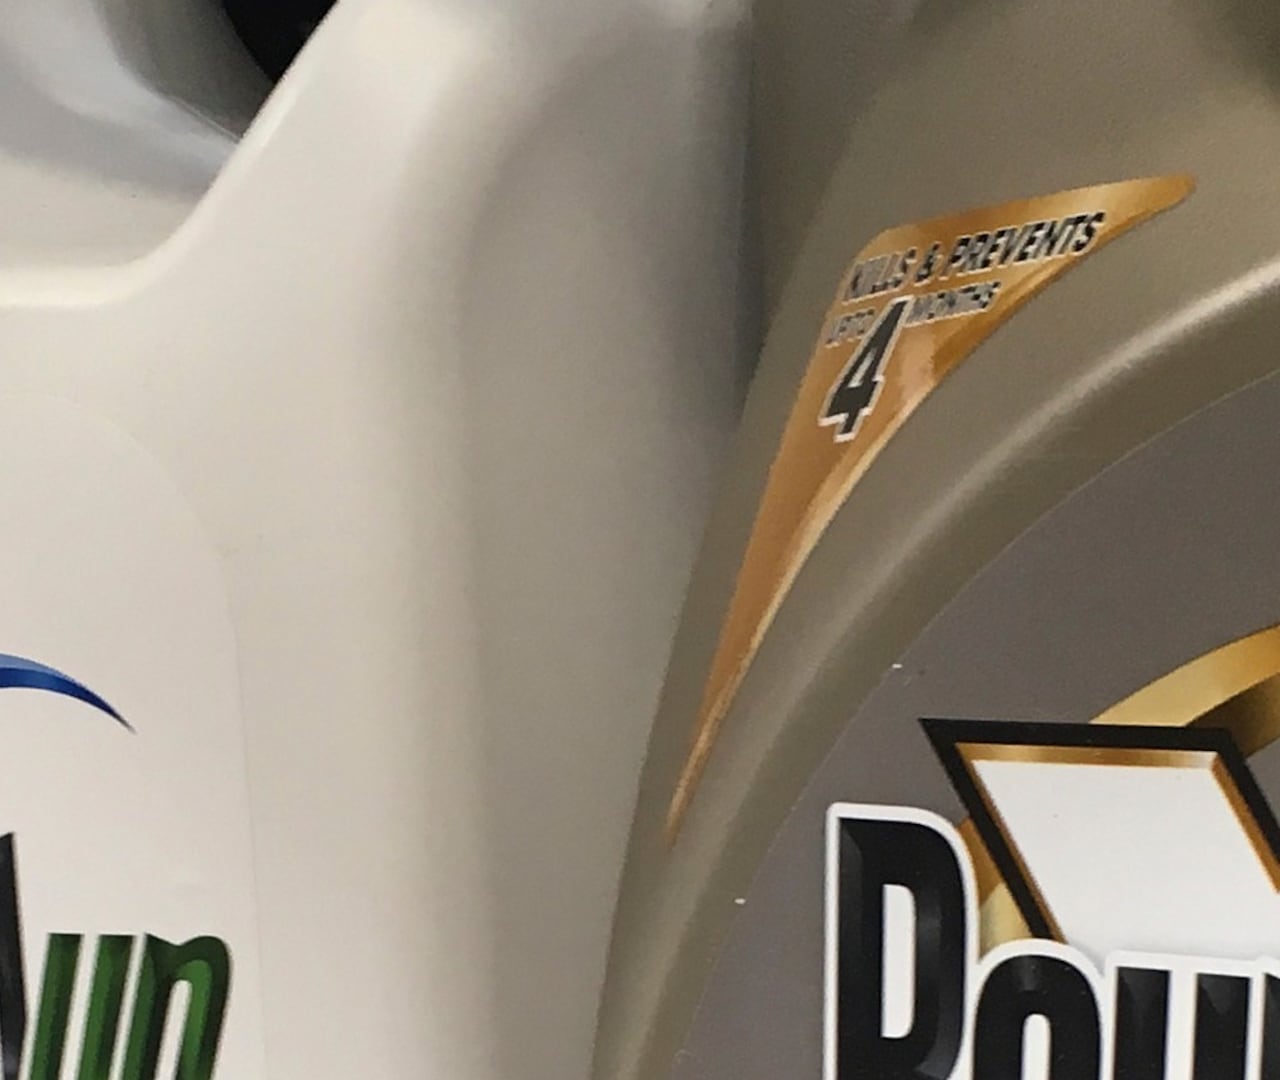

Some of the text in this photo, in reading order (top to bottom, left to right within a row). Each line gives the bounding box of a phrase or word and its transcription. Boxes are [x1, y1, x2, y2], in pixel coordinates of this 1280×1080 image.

[840, 245, 918, 306] KILLS
[938, 210, 1106, 280] PREVENTS
[819, 295, 913, 443] 4
